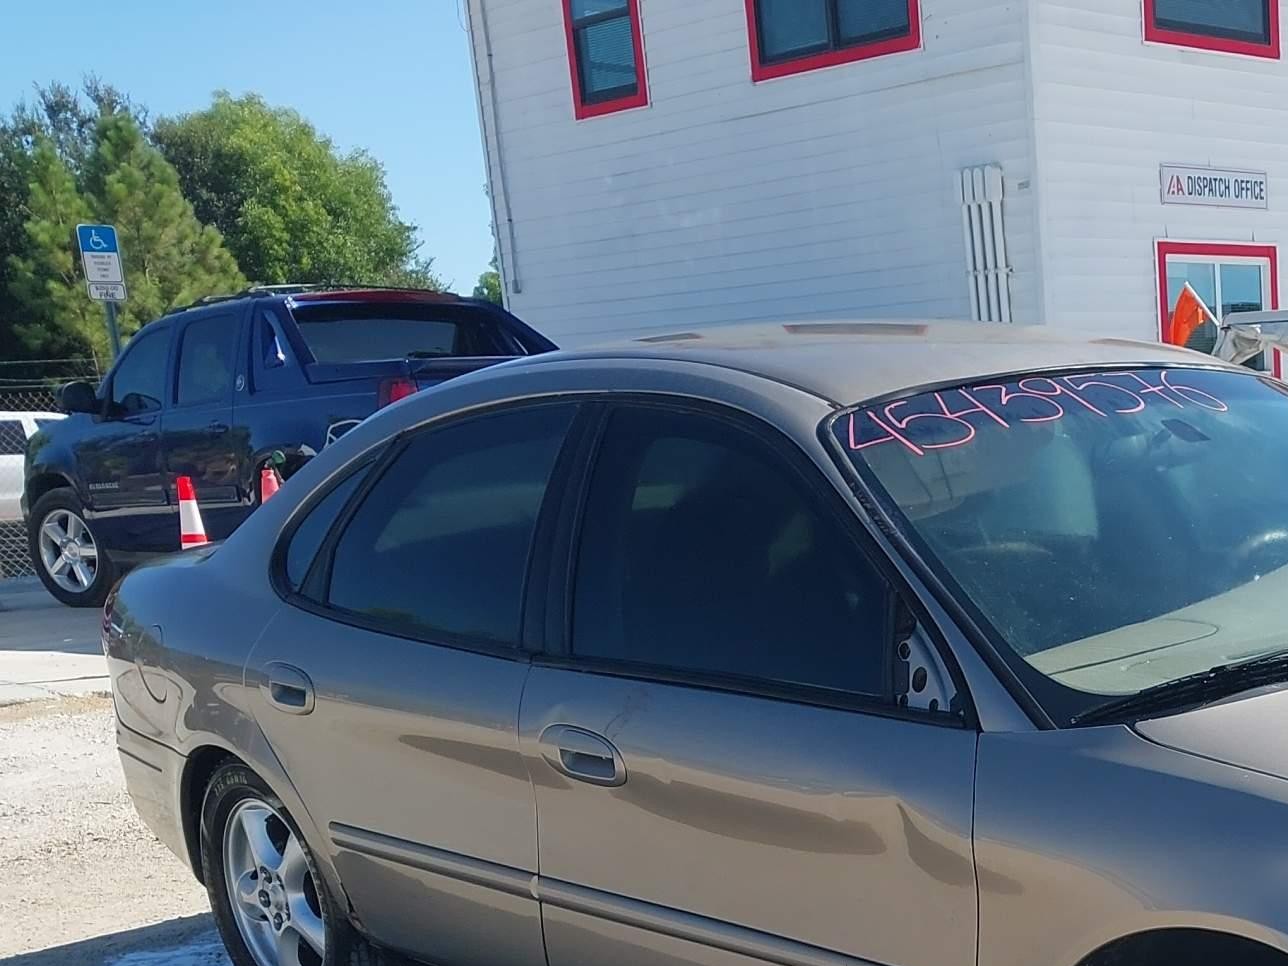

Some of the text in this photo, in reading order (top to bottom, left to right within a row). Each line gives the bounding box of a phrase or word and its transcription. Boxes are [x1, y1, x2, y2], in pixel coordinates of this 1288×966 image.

[1187, 175, 1231, 198] DISPATCH
[1233, 178, 1265, 200] OFFICE
[847, 370, 1229, 456] 45439576
